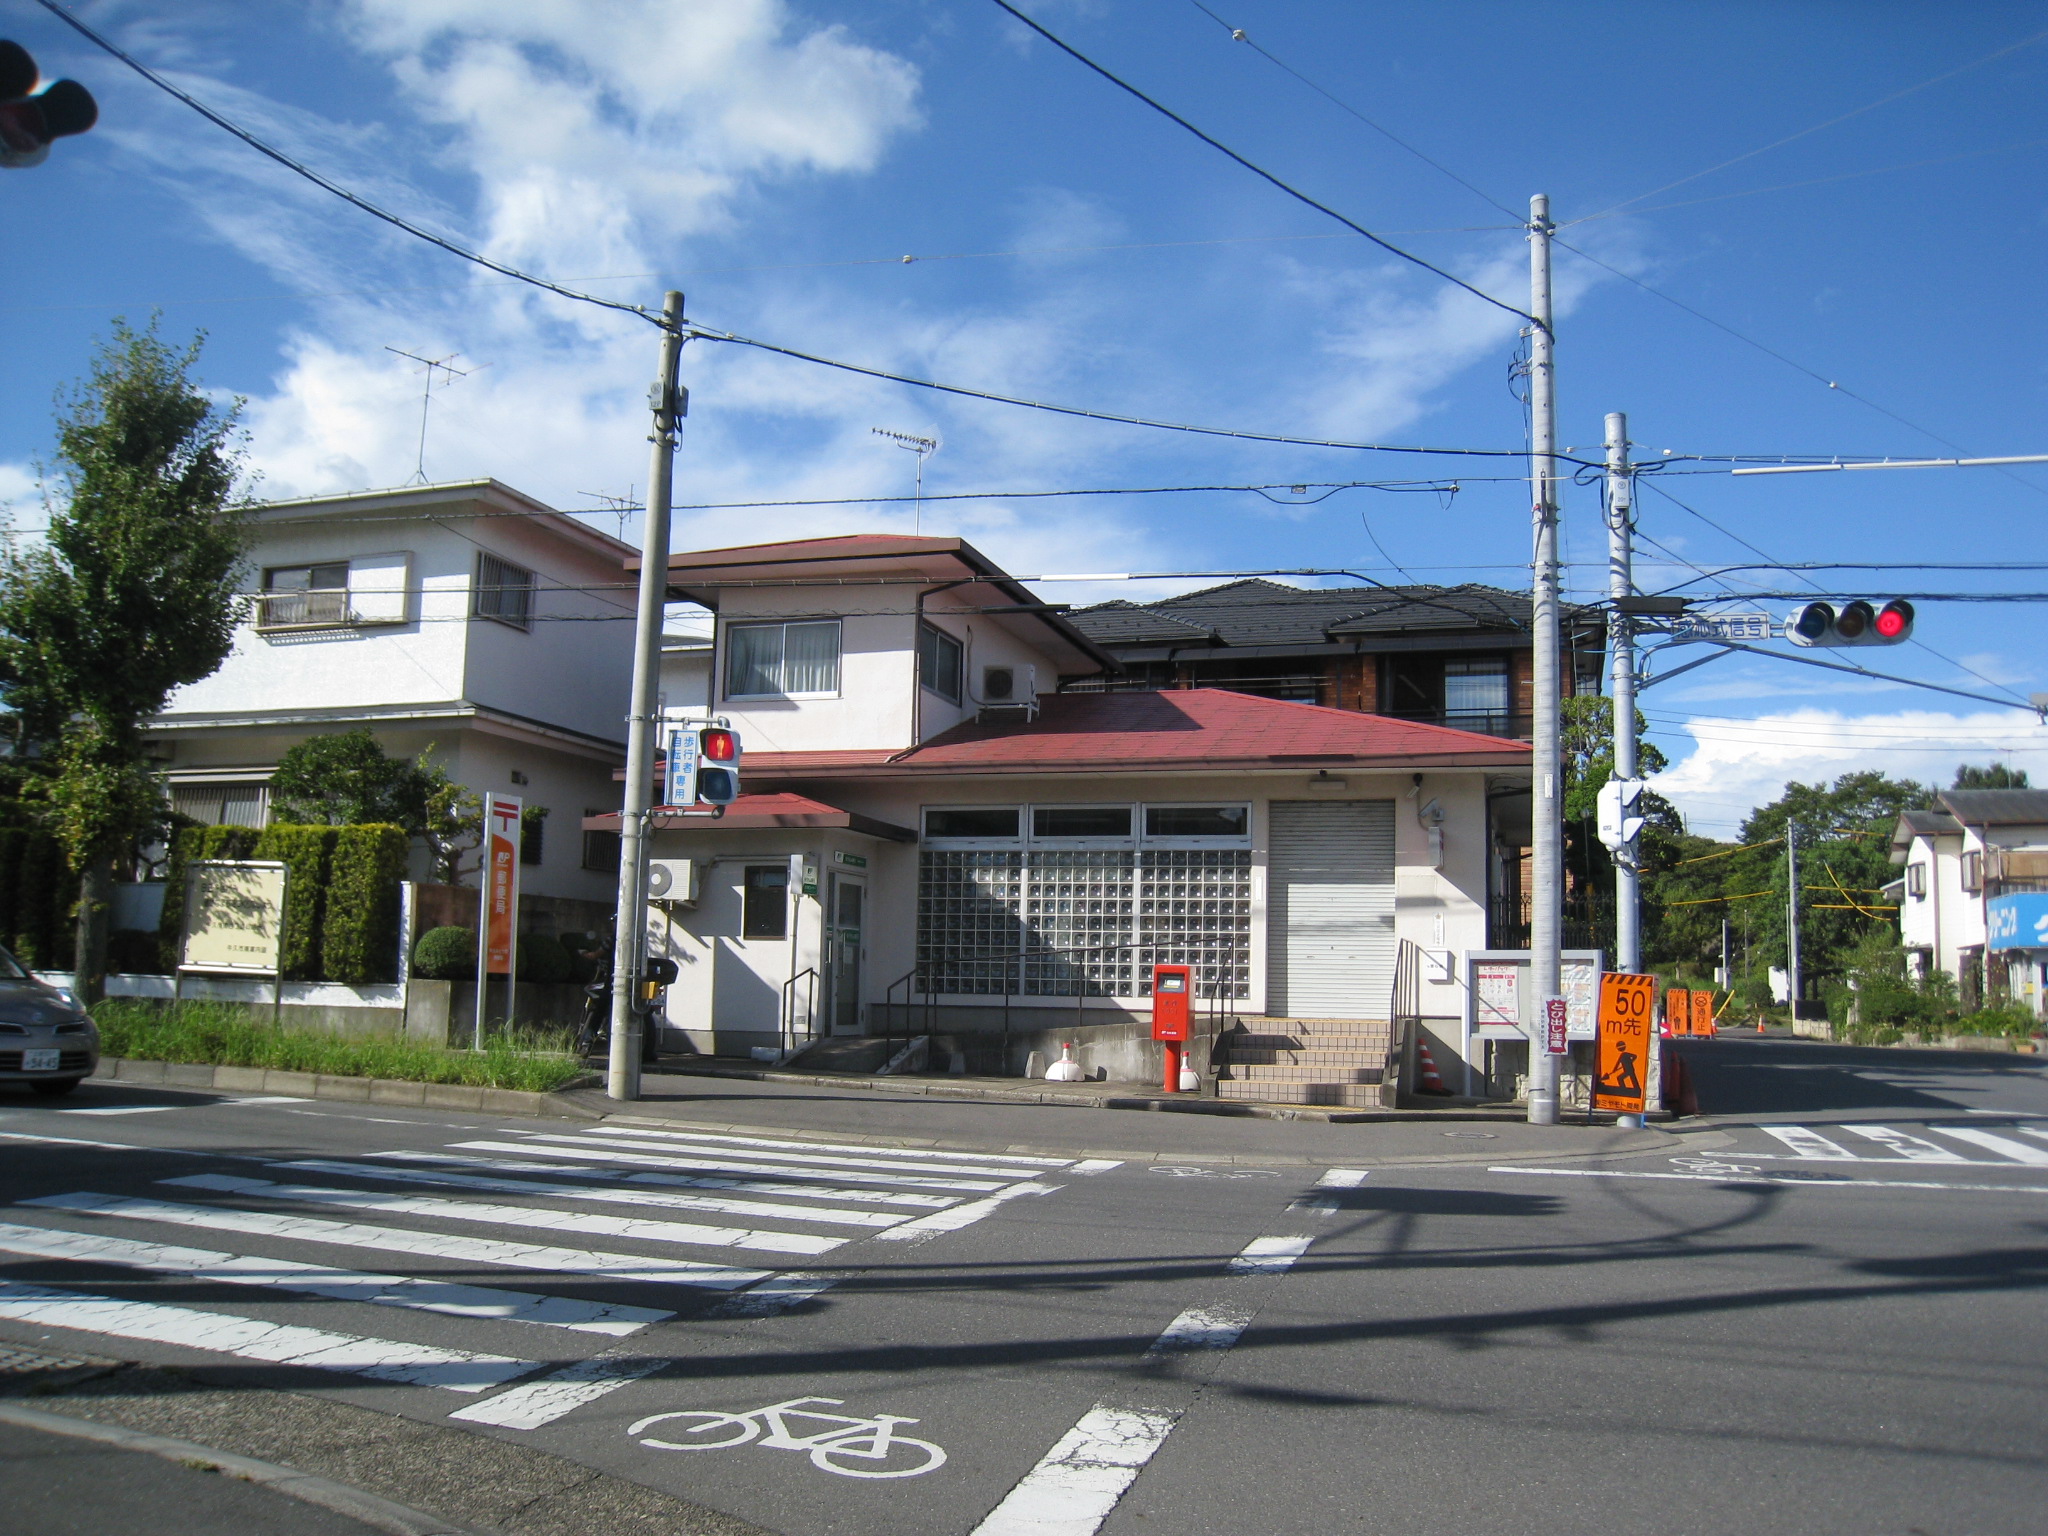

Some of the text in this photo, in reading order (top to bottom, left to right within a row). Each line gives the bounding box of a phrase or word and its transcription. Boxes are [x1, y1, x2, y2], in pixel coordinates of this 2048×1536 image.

[671, 737, 682, 773] 自転車
[683, 736, 694, 773] 歩行者
[675, 775, 686, 800] 専用
[1615, 989, 1646, 1016] 50
[1550, 1002, 1563, 1048] とび出し注意
[1606, 1018, 1641, 1036] m先
[1697, 1008, 1706, 1031] 通行止
